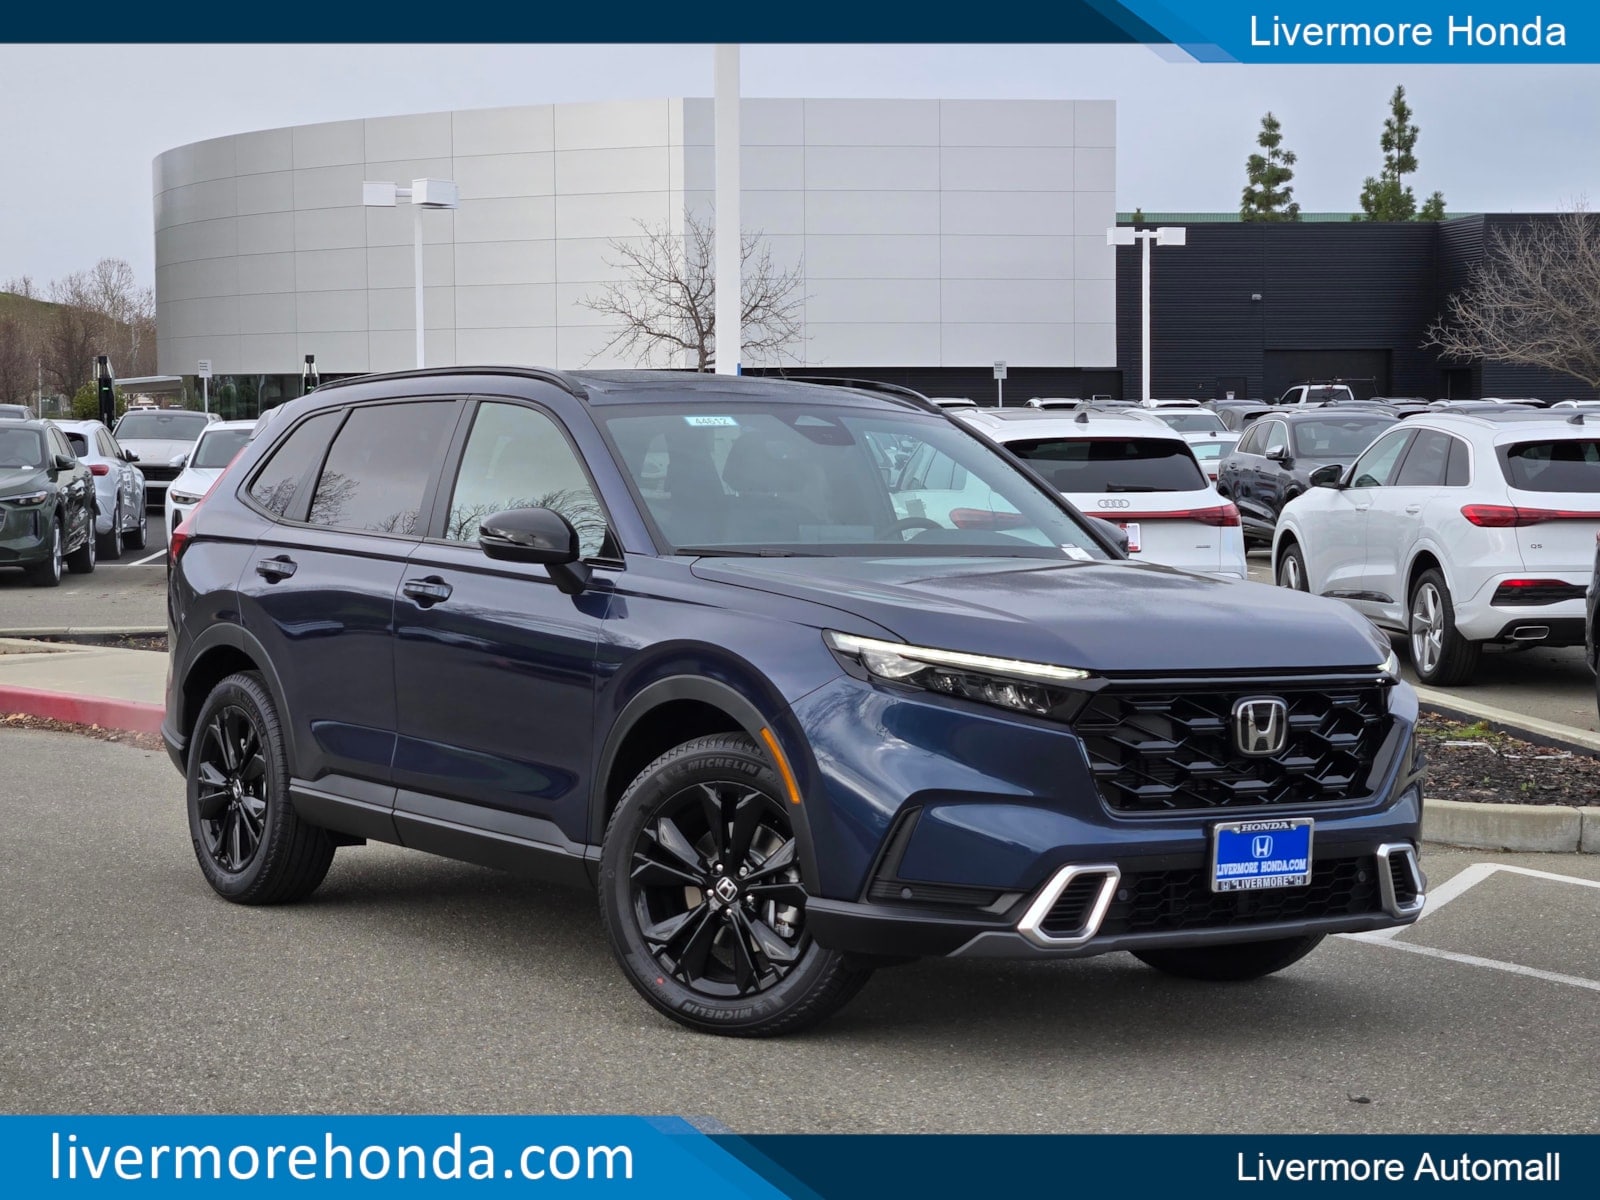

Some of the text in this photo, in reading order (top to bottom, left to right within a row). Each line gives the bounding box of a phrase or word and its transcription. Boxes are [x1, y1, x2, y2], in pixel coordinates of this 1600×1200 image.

[687, 758, 758, 775] MICHELIN
[1241, 821, 1290, 832] HONDA
[1216, 858, 1307, 876] LIVERMORE HONDA.COM
[1236, 876, 1290, 890] LIVERMORE
[682, 1001, 753, 1020] MICHELIN
